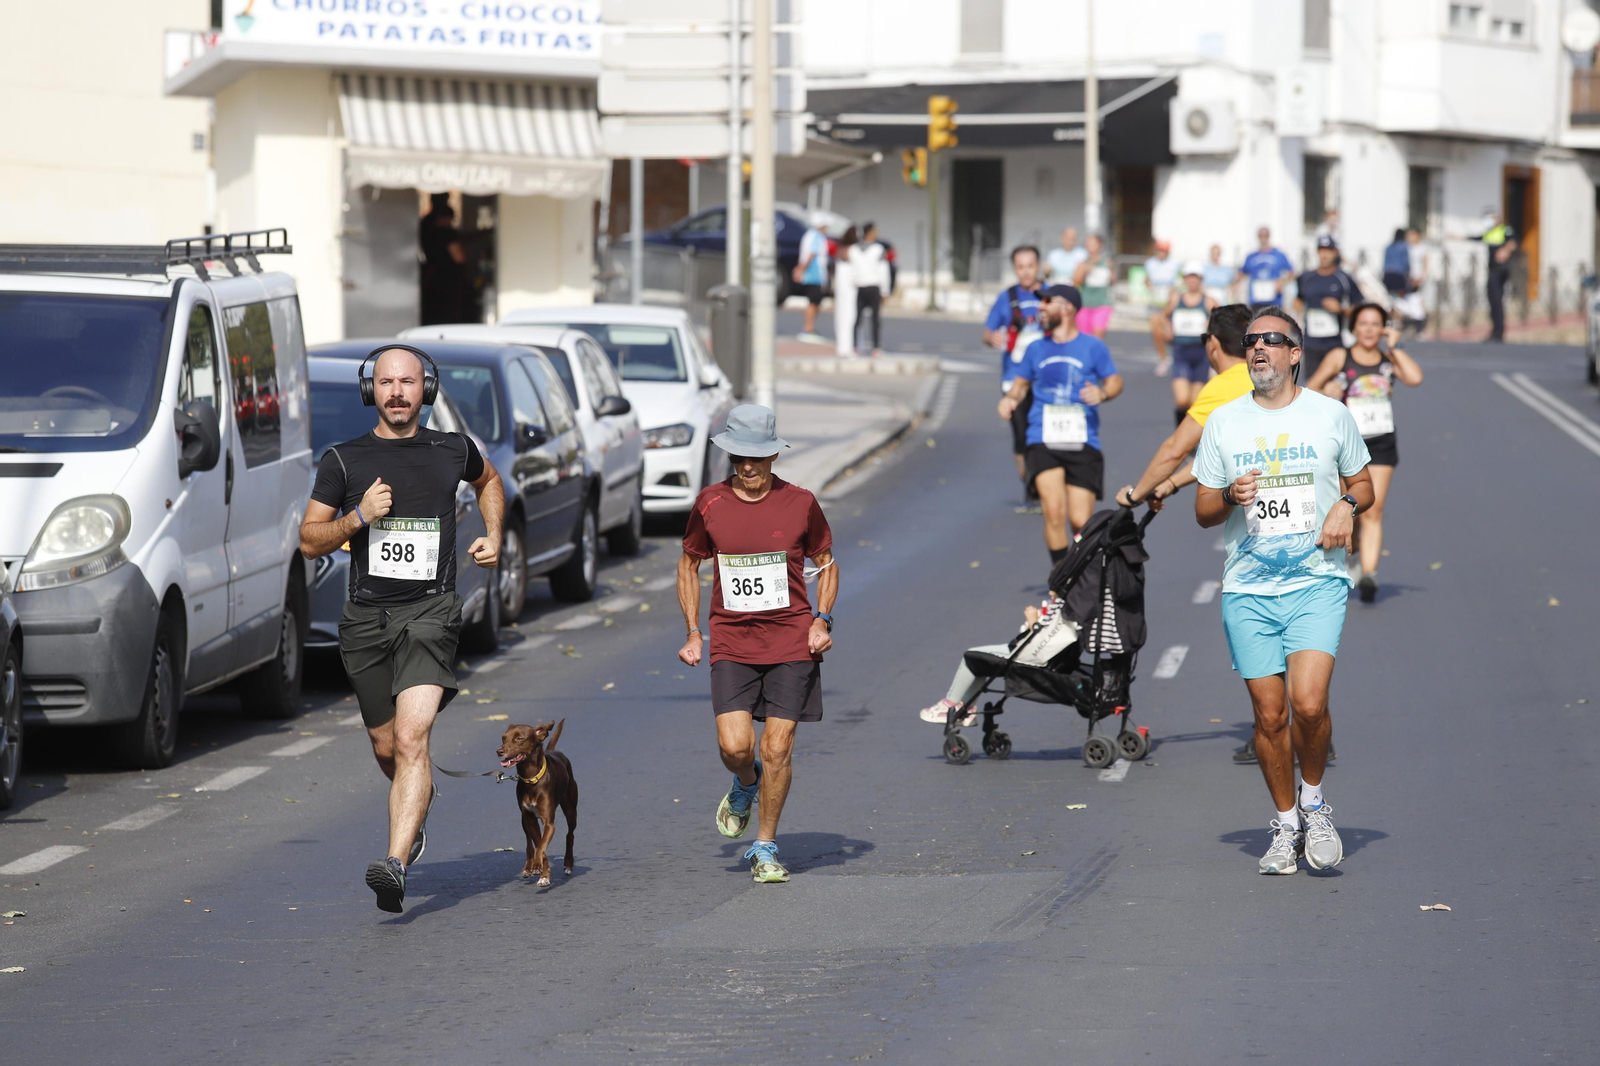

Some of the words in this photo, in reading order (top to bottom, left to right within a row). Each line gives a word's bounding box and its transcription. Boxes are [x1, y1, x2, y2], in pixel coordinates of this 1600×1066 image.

[272, 0, 427, 17] CHURROS
[318, 21, 467, 44] PATATAS
[480, 29, 592, 51] FRITAS
[1233, 442, 1318, 467] TRAVESÍA
[1280, 478, 1285, 486] A
[1285, 475, 1309, 485] HUELVA
[1257, 498, 1291, 519] 364
[383, 521, 405, 531] VUELTA
[407, 521, 412, 530] A
[413, 521, 436, 531] HUELVA
[381, 542, 415, 563] 598
[730, 557, 752, 566] VUELTA
[753, 557, 758, 565] A
[759, 554, 781, 565] HUELVA
[732, 577, 764, 596] 365
